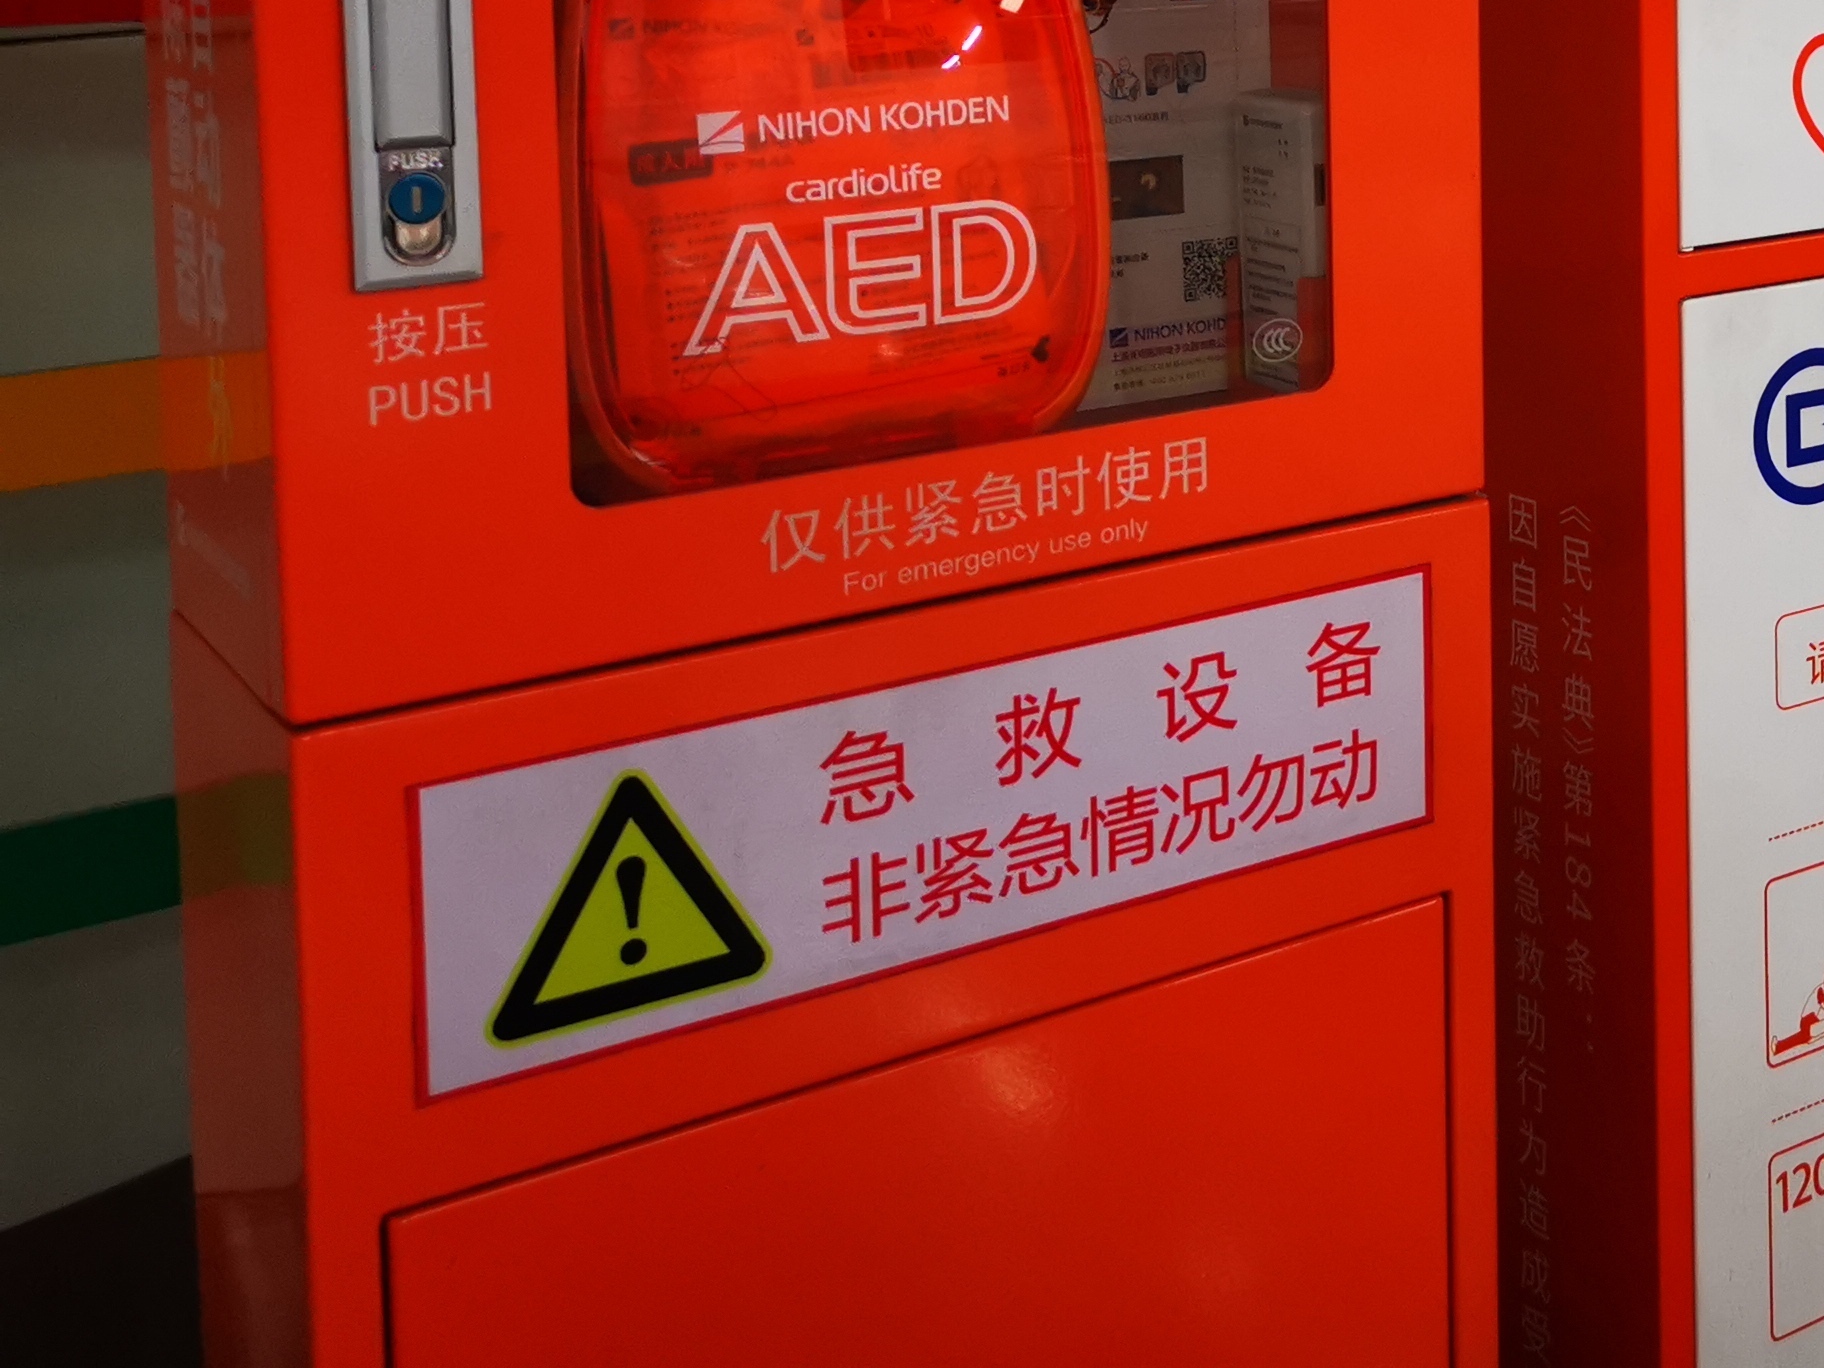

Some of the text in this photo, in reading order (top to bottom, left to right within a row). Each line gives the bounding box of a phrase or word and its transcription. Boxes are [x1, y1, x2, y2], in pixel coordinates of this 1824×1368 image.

[759, 95, 1011, 143] NIHON KOHDEN
[785, 162, 943, 205] cardiolife
[682, 199, 1038, 357] AED
[368, 302, 489, 363] 按压
[368, 371, 492, 427] PUSH
[761, 435, 1210, 575] 仅供紧急时使用
[843, 516, 1148, 596] For emergency use only
[819, 620, 1382, 826] 急救设备
[822, 727, 1379, 945] 非紧急情况勿动
